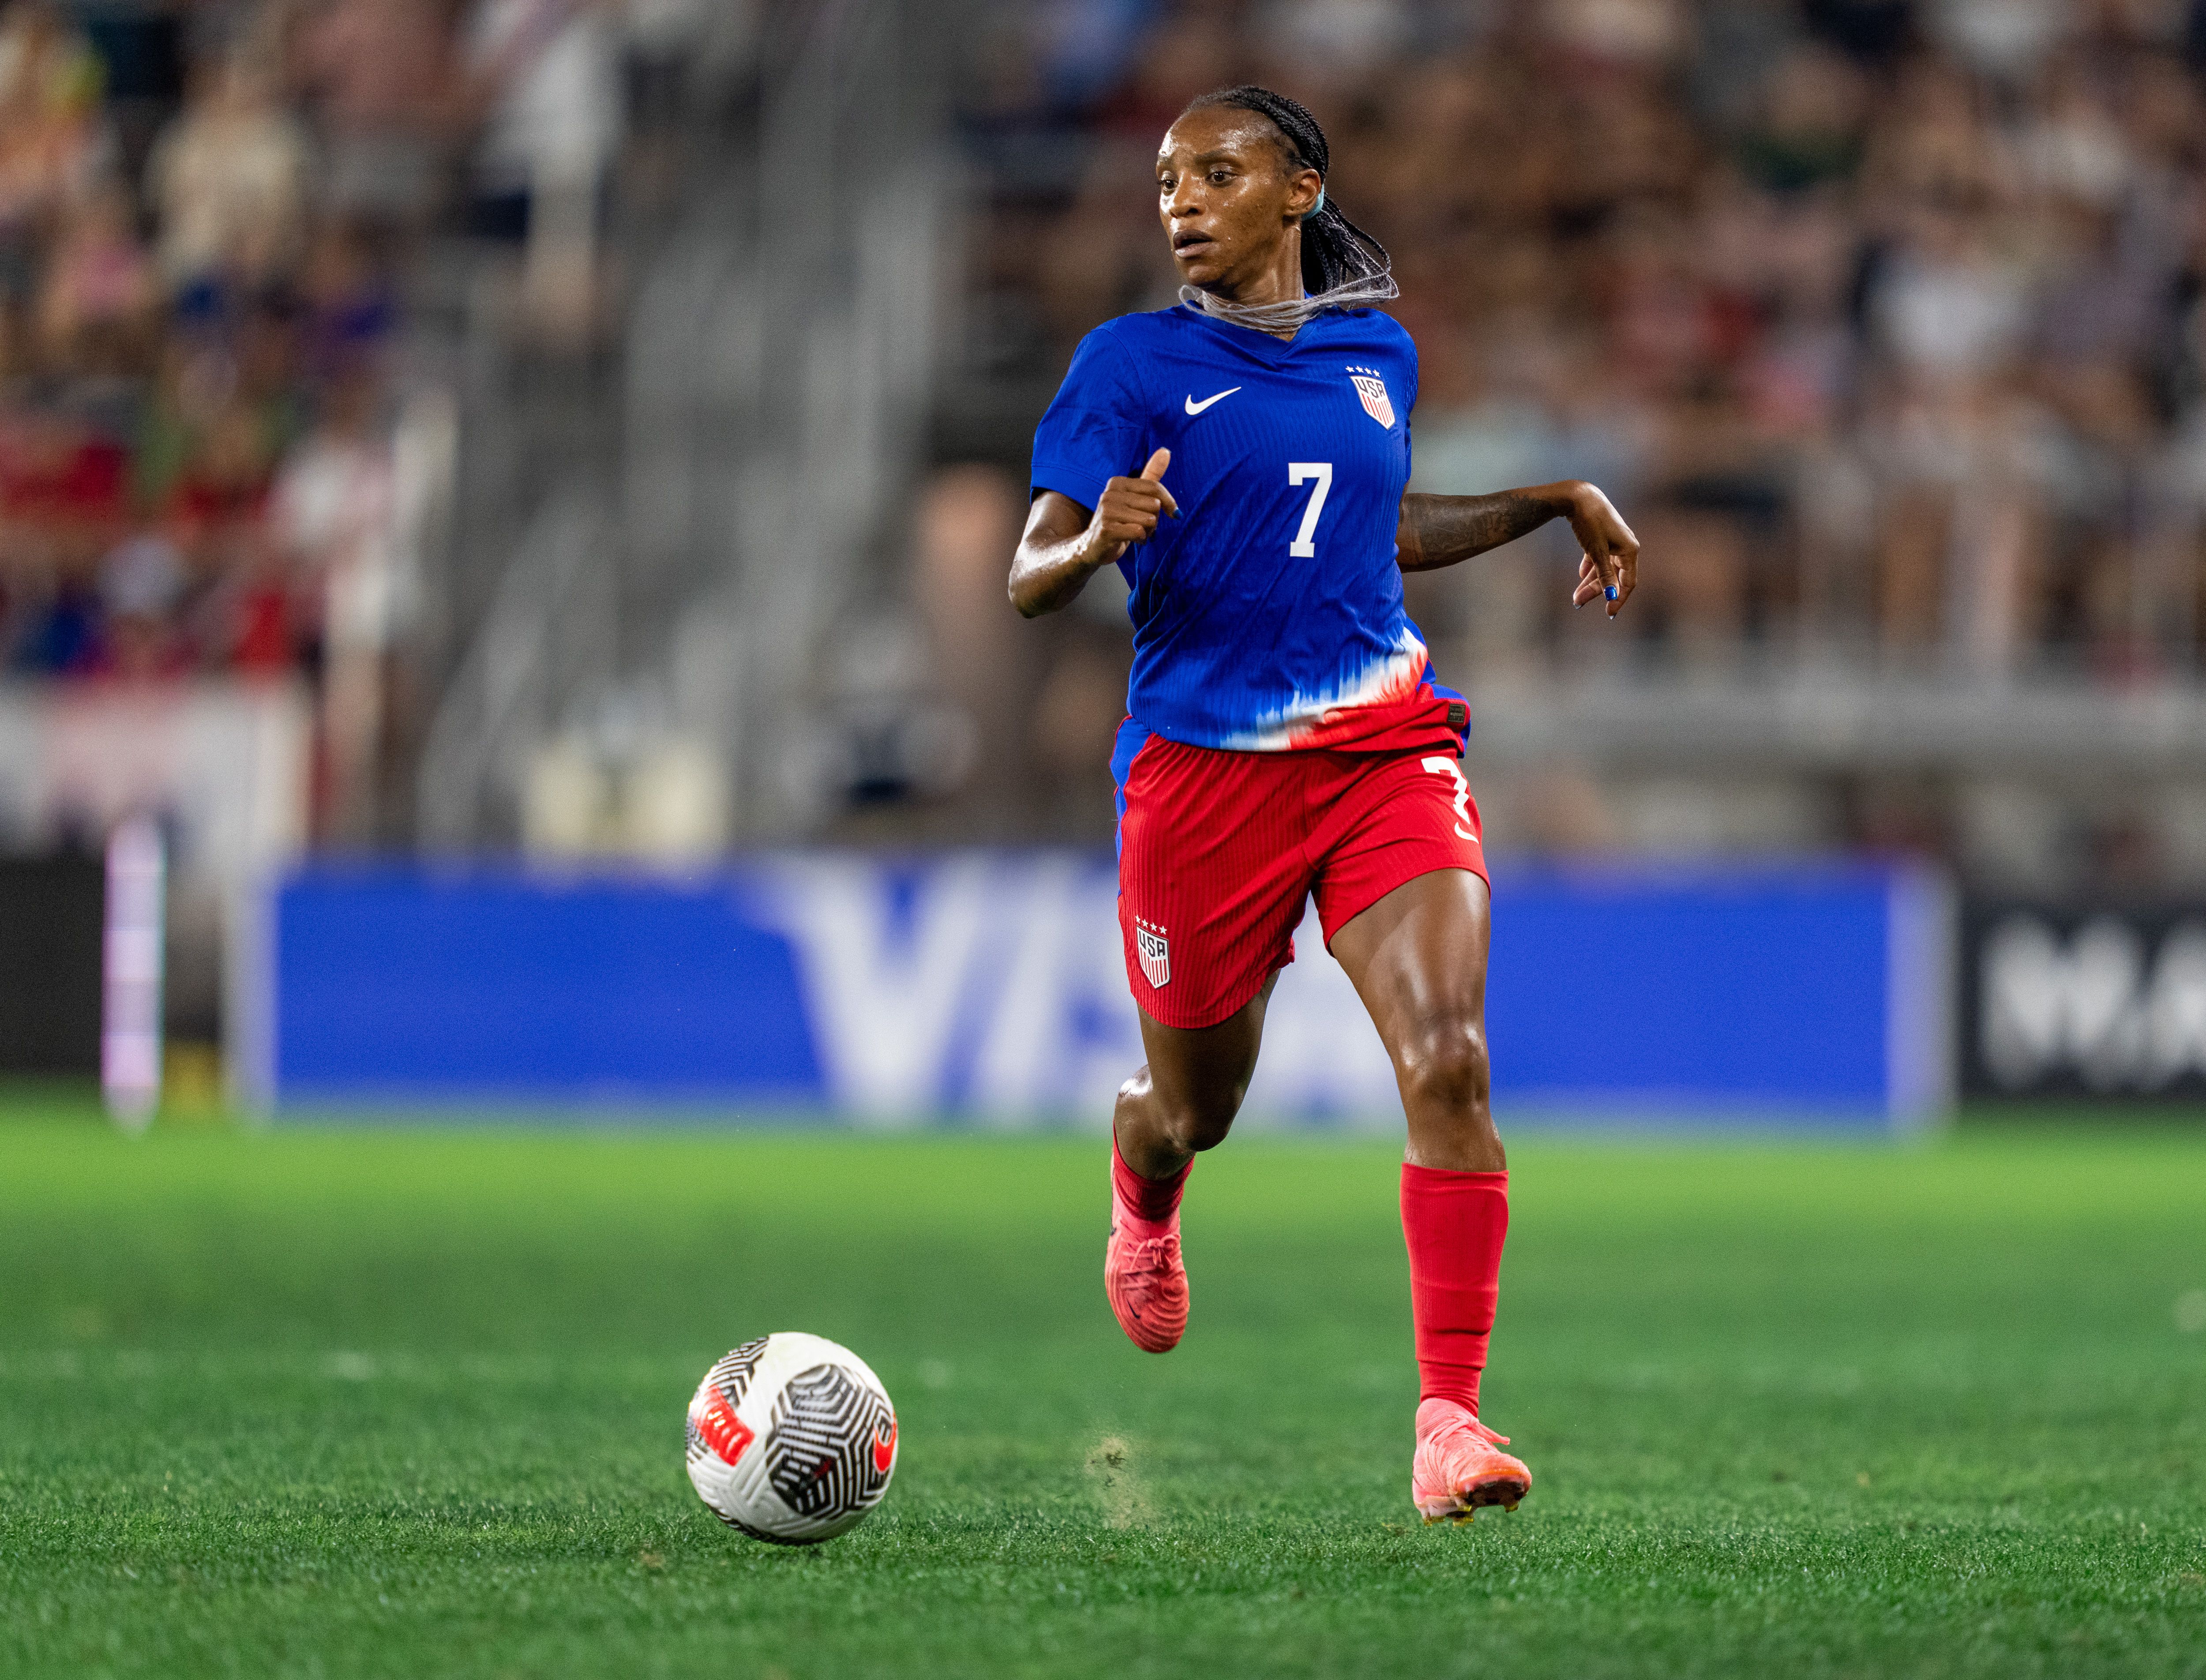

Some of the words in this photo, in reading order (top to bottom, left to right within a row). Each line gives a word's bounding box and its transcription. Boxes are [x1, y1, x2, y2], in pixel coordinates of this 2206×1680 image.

[1355, 379, 1385, 398] USA
[1288, 462, 1332, 558] 7
[1421, 756, 1471, 825] 7
[1139, 930, 1166, 958] USA
